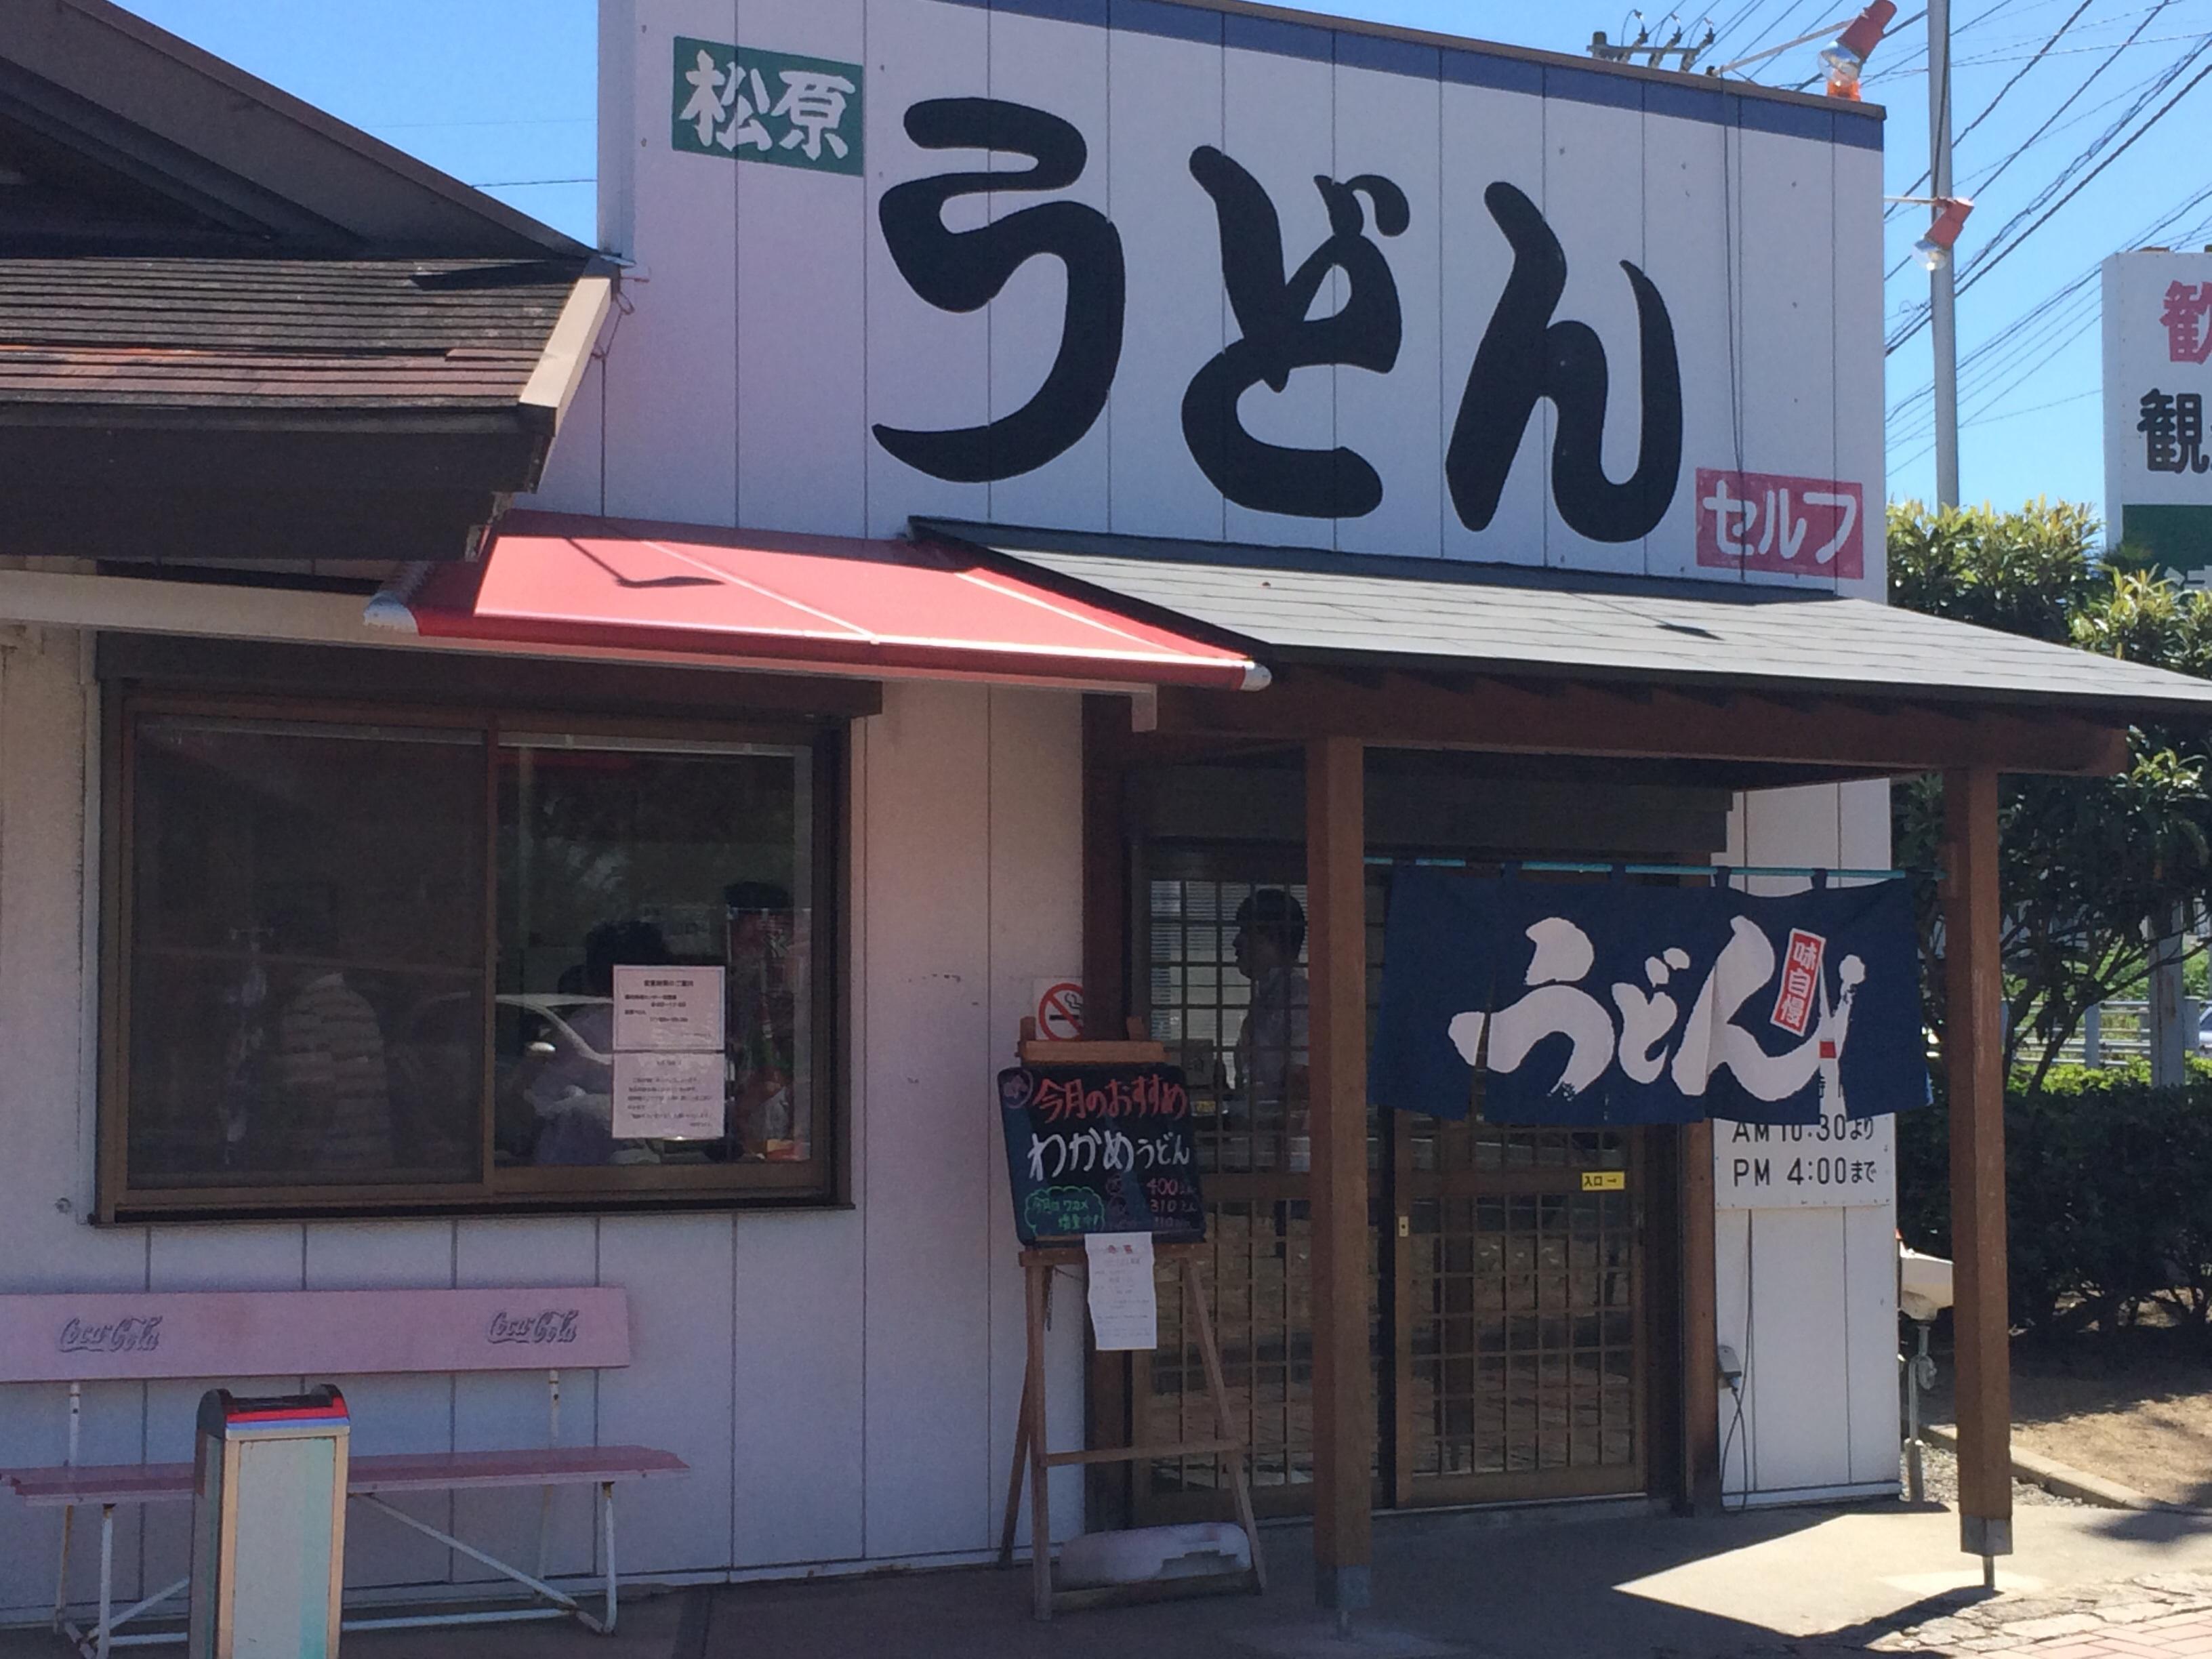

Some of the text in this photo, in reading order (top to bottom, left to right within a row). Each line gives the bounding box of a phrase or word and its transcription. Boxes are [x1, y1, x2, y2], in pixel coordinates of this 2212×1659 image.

[679, 49, 855, 161] 松原
[872, 98, 1683, 542] うどん
[2136, 388, 2212, 474] 観
[1702, 479, 1857, 565] セルフ
[1448, 915, 1866, 1103] うどん
[1779, 941, 1818, 1028] 味自慢
[1032, 1073, 1186, 1124] 今月のおすすめ
[1027, 1127, 1190, 1181] わかめうどん
[1584, 1175, 1603, 1187] 入口
[1734, 1158, 1770, 1187] PM
